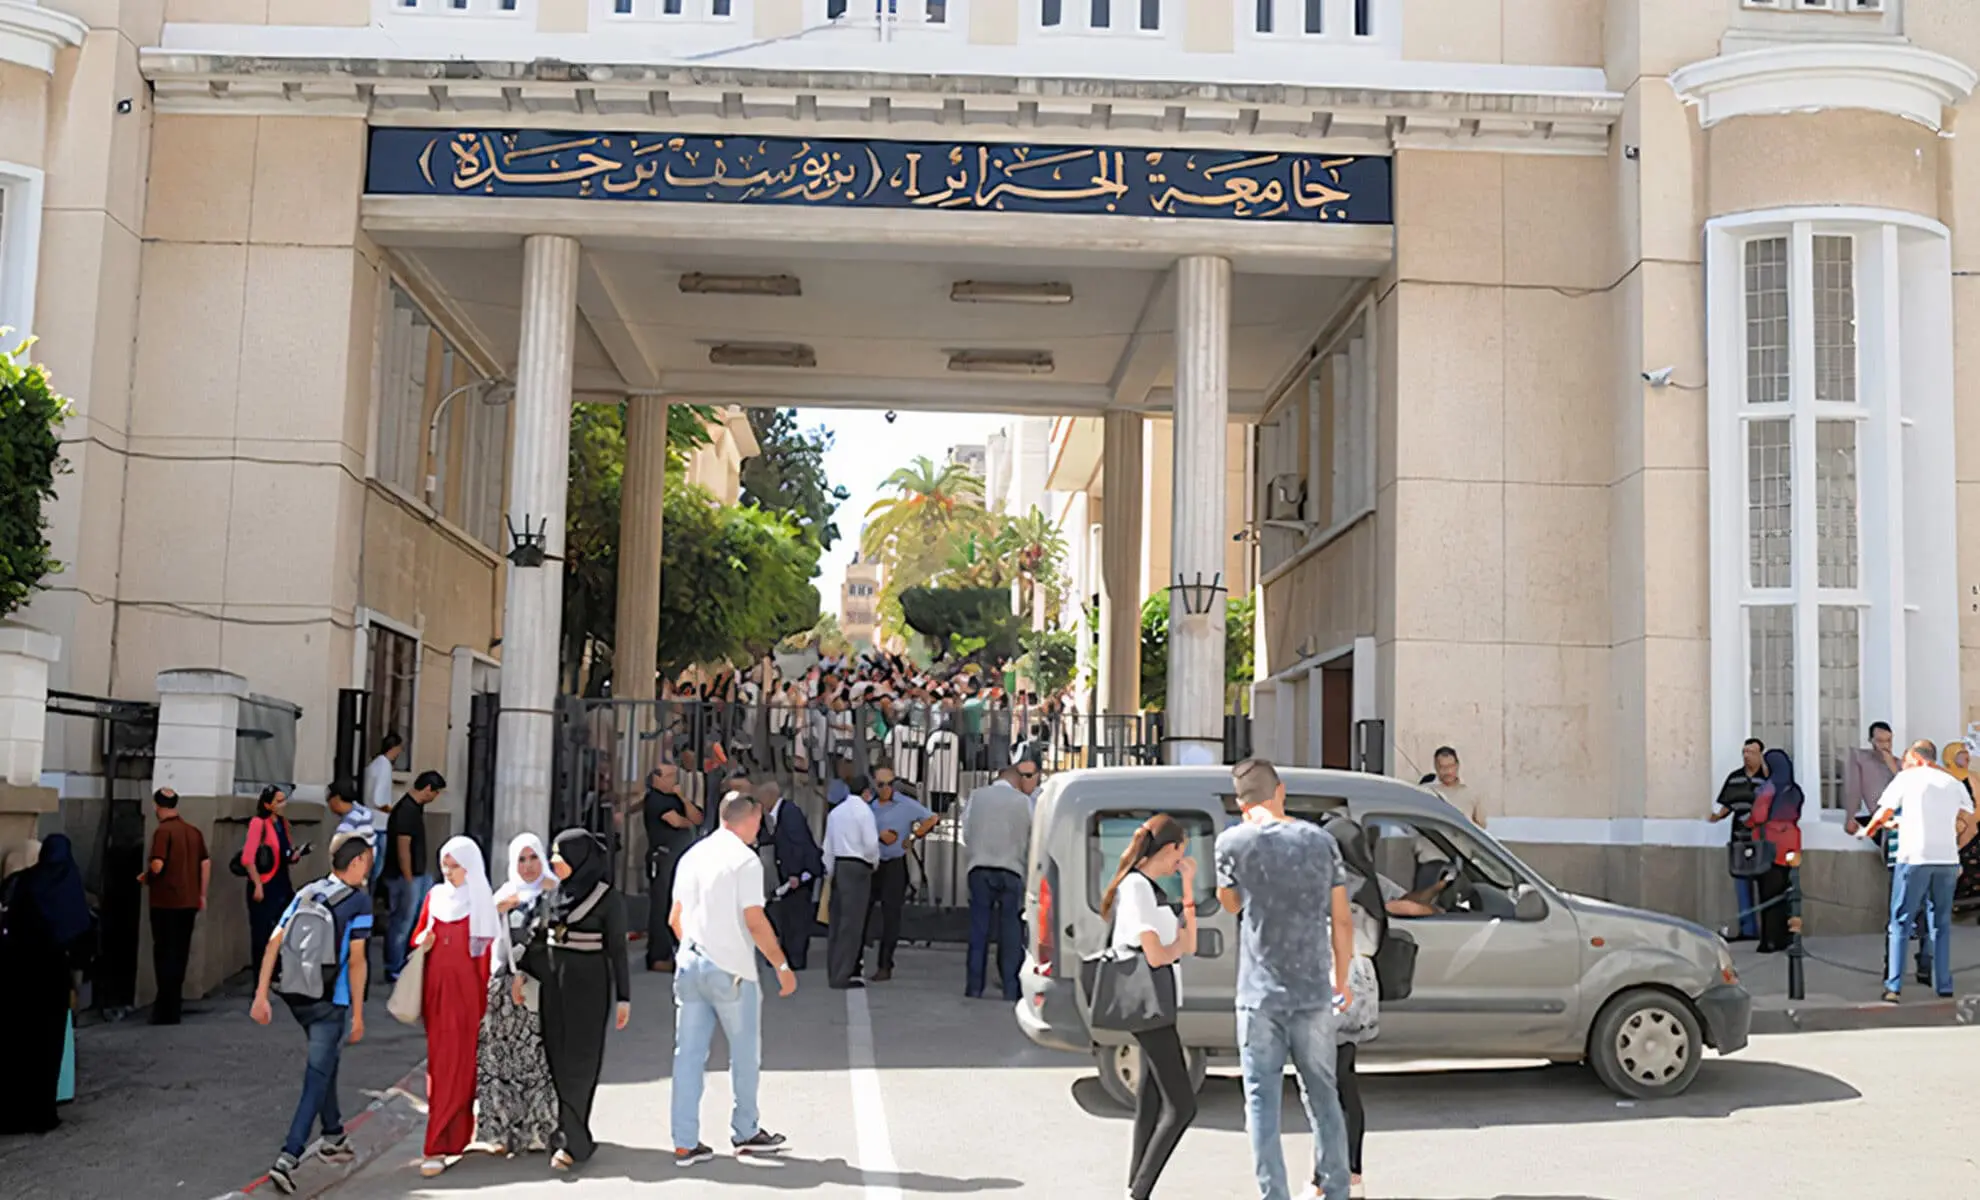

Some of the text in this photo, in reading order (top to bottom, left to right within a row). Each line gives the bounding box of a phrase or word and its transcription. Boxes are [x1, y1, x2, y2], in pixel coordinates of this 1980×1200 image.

[602, 138, 667, 197] بن
[911, 146, 1129, 212] الجزائر
[1145, 151, 1354, 220] جامعة
